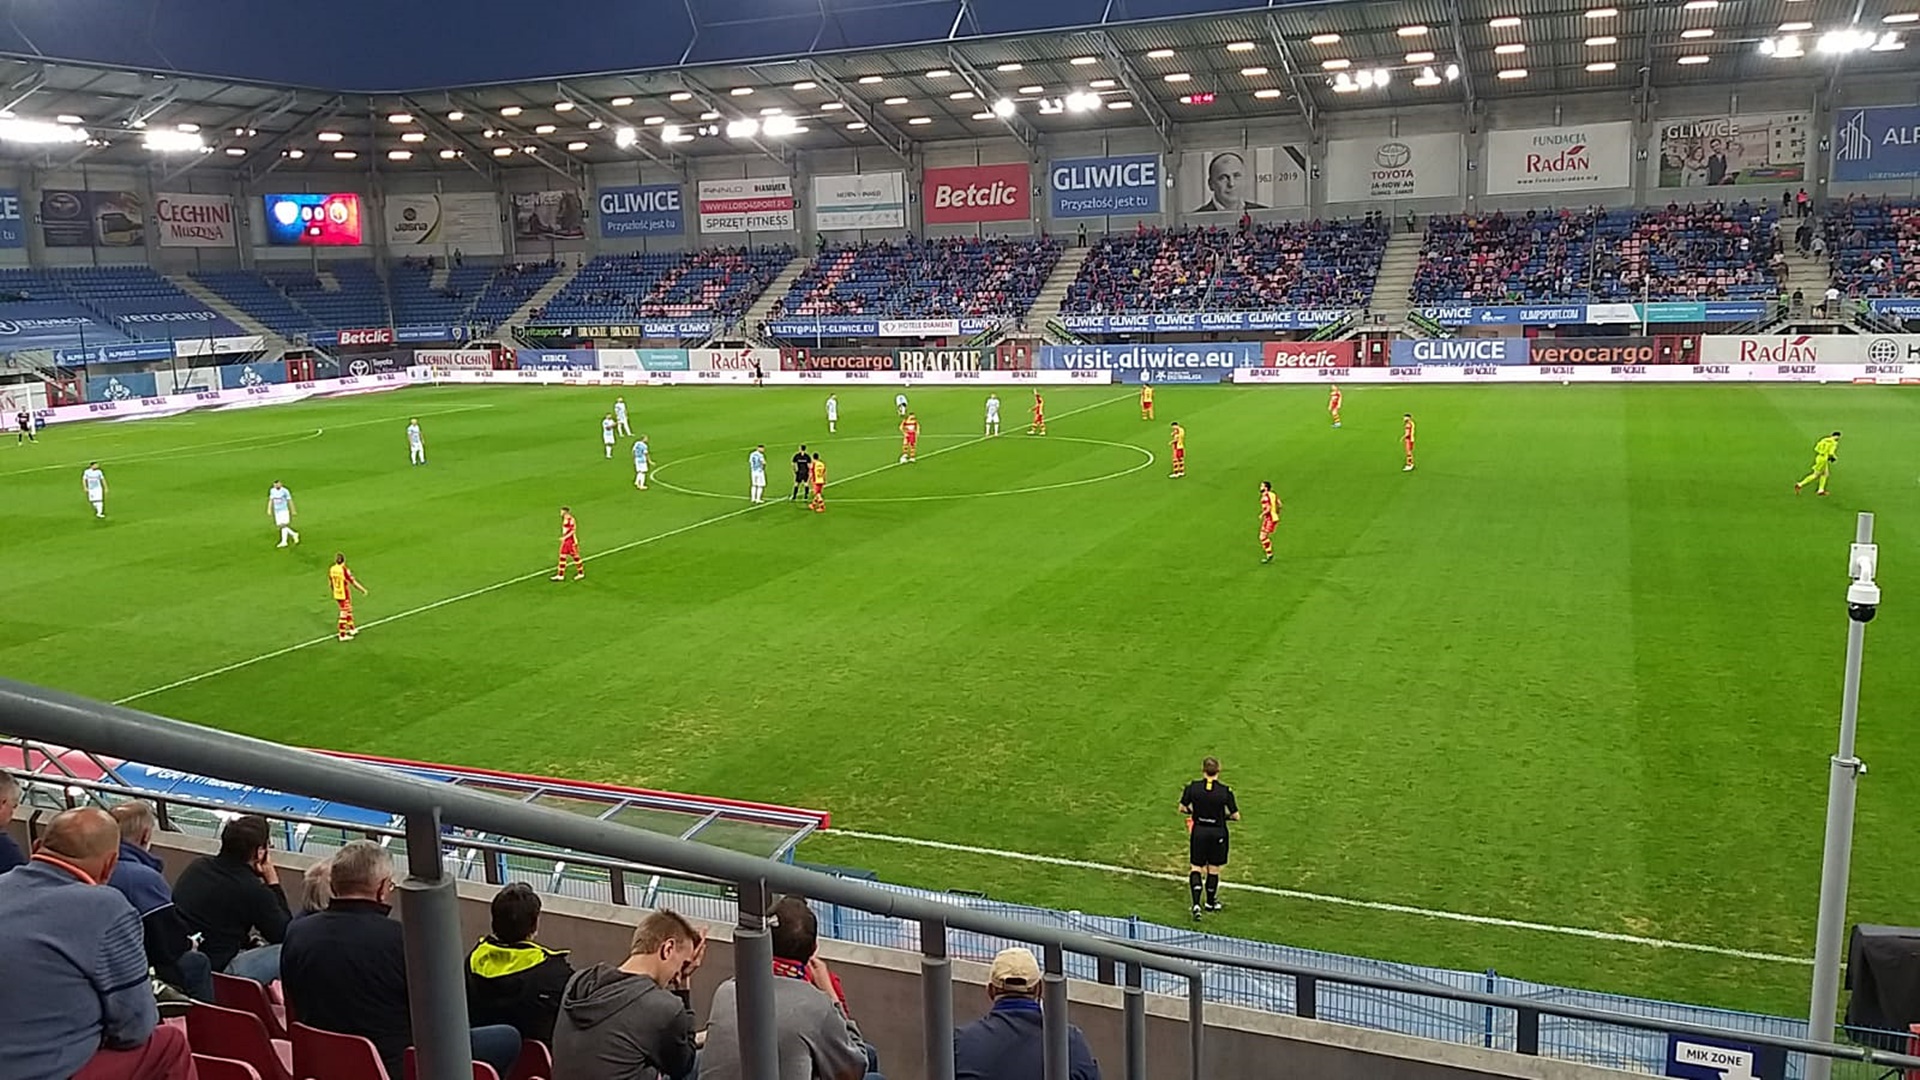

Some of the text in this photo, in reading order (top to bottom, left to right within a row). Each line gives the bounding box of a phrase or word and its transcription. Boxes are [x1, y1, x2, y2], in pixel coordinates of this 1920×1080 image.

[1533, 132, 1587, 146] FUNDACJA
[1667, 123, 1740, 139] GLIWICE
[1053, 163, 1156, 190] GLIWICE
[1372, 169, 1414, 180] TOYOTA
[600, 190, 680, 214] GLIWICE
[935, 181, 1018, 208] Betclic
[1061, 195, 1148, 211] Przyszłość jest tu
[157, 200, 231, 223] CECHINI
[706, 215, 789, 230] SPRZĘT FITNESS
[119, 310, 217, 324] verocargo
[1109, 316, 1150, 326] GLIWICE
[1154, 314, 1195, 325] GLIWICE
[1201, 312, 1244, 323] GLIWICE
[1248, 312, 1291, 322] GLIWICE
[341, 331, 389, 345] Betclic
[1063, 347, 1234, 369] visit.gliwice.eu
[1275, 350, 1337, 367] Betclic
[1413, 341, 1505, 360] GLIWICE
[1531, 346, 1653, 364] verocargo
[810, 353, 893, 370] verocargo
[899, 350, 982, 371] BRACKIE
[1686, 1048, 1743, 1067] MIX ZONE
